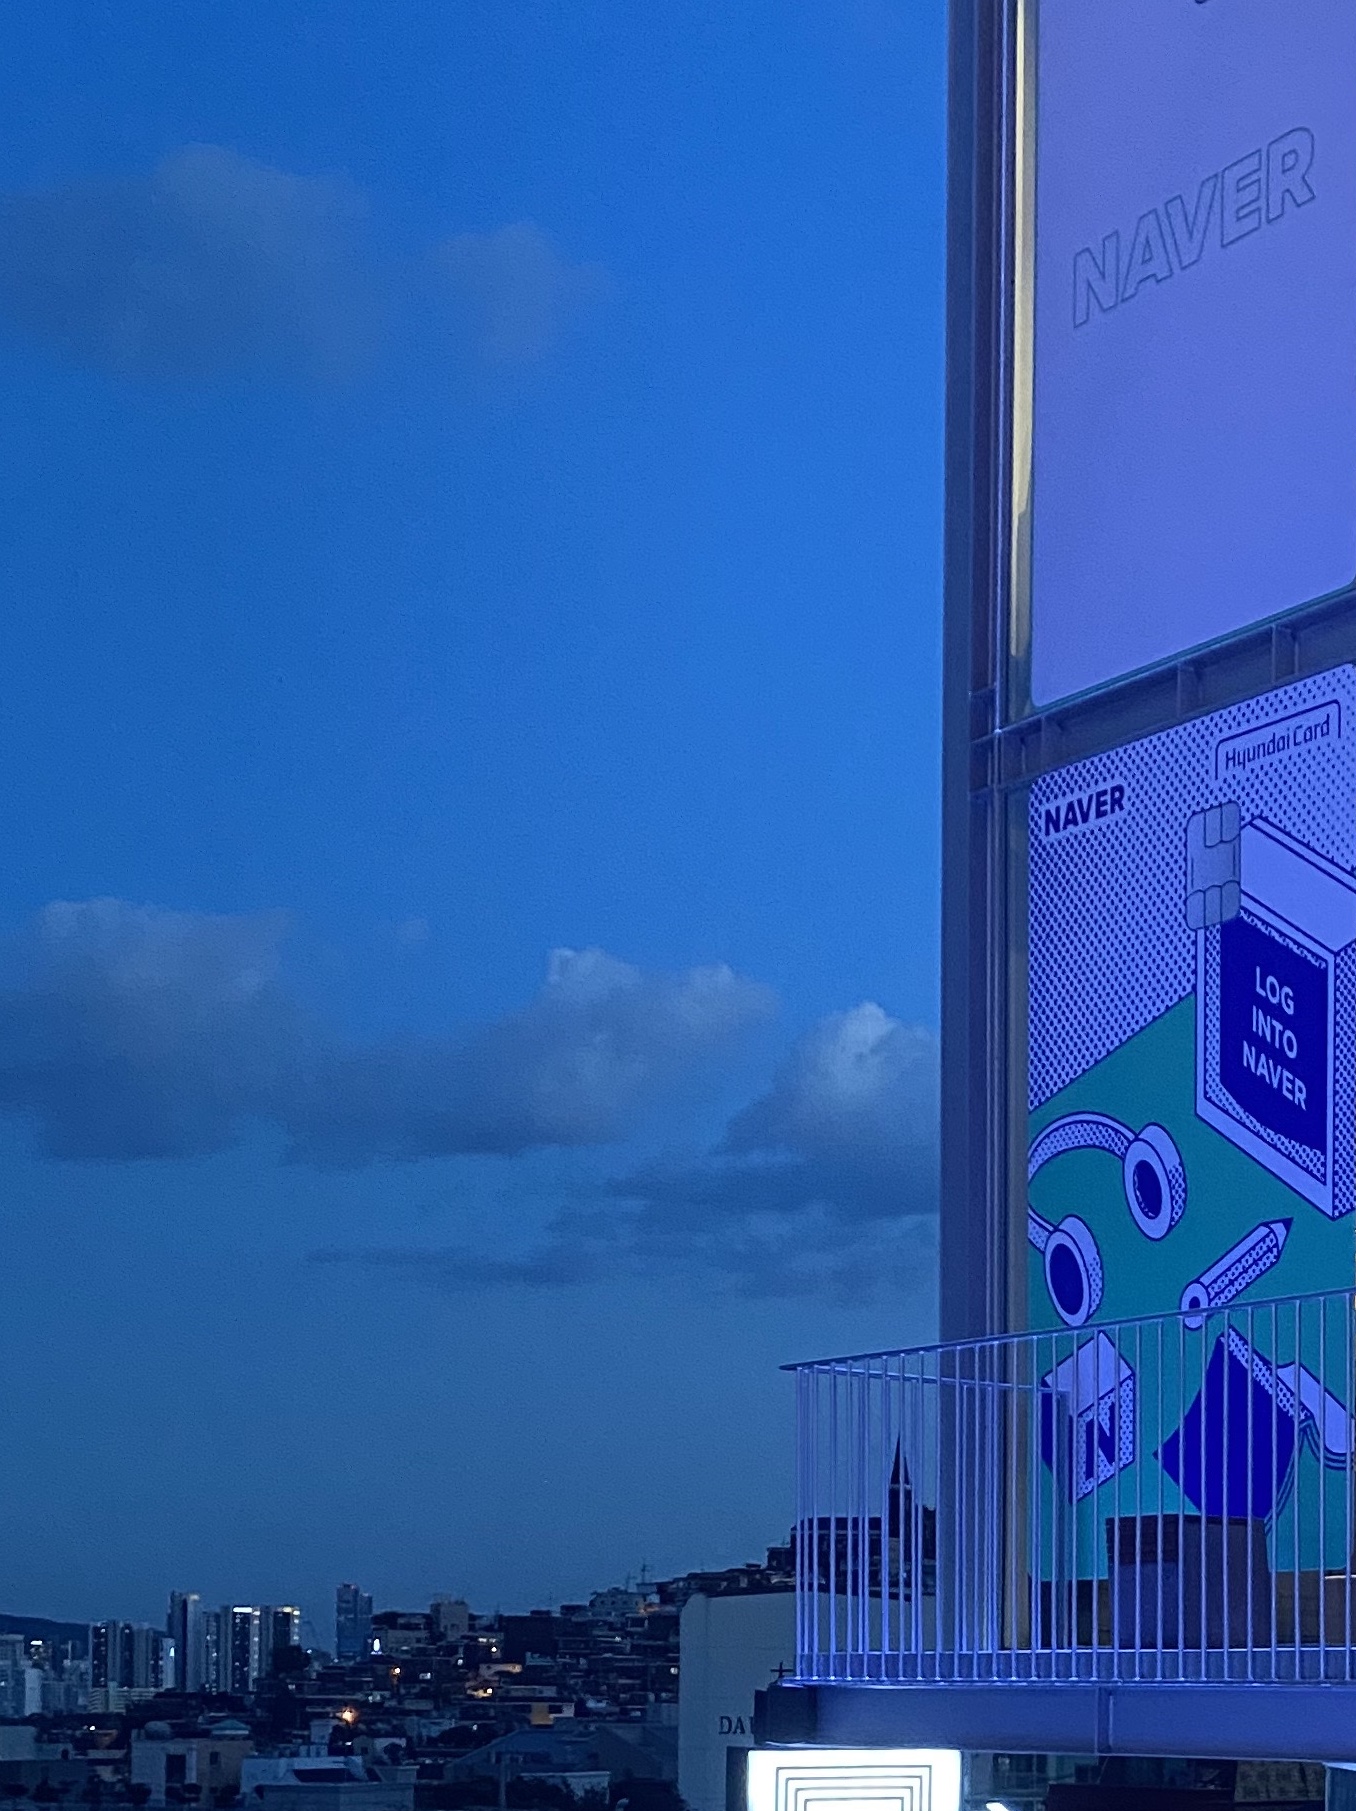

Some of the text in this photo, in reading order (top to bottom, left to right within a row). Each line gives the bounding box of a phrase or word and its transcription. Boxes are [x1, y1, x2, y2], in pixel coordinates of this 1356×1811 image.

[1072, 126, 1317, 330] NAVER
[1224, 713, 1332, 771] Hyundai Card
[1044, 783, 1126, 838] NAVER
[1254, 965, 1295, 1016] LOG
[1251, 1004, 1298, 1060] INTO
[1242, 1040, 1308, 1111] NAVER
